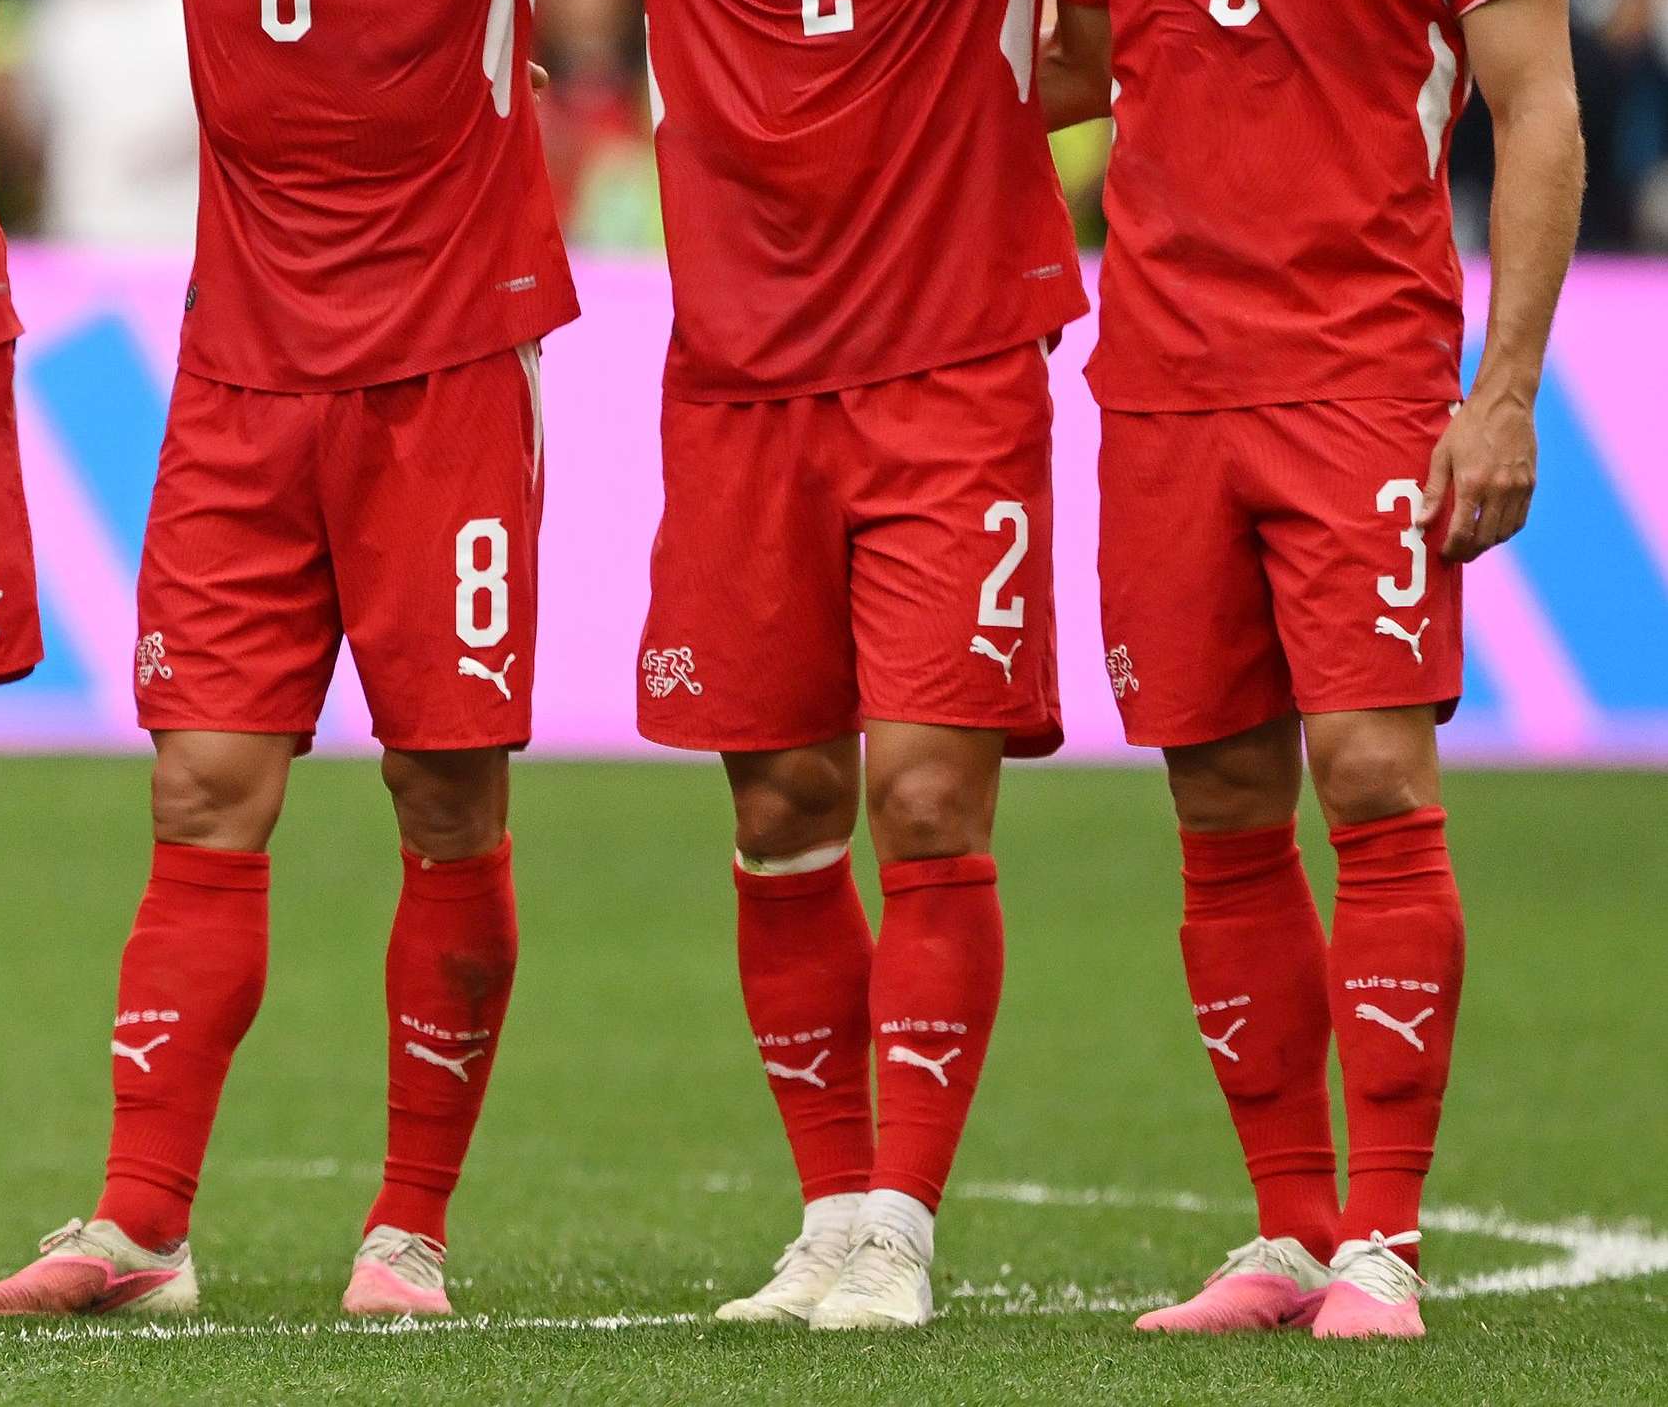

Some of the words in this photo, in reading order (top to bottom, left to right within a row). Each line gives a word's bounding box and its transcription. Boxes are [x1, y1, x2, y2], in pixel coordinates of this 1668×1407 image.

[1376, 478, 1427, 608] 3
[977, 500, 1028, 628] 2
[455, 517, 509, 648] 8
[1345, 975, 1440, 994] suisse
[115, 1009, 181, 1028] uisse
[880, 1017, 968, 1035] suisse
[754, 1026, 832, 1047] uisse
